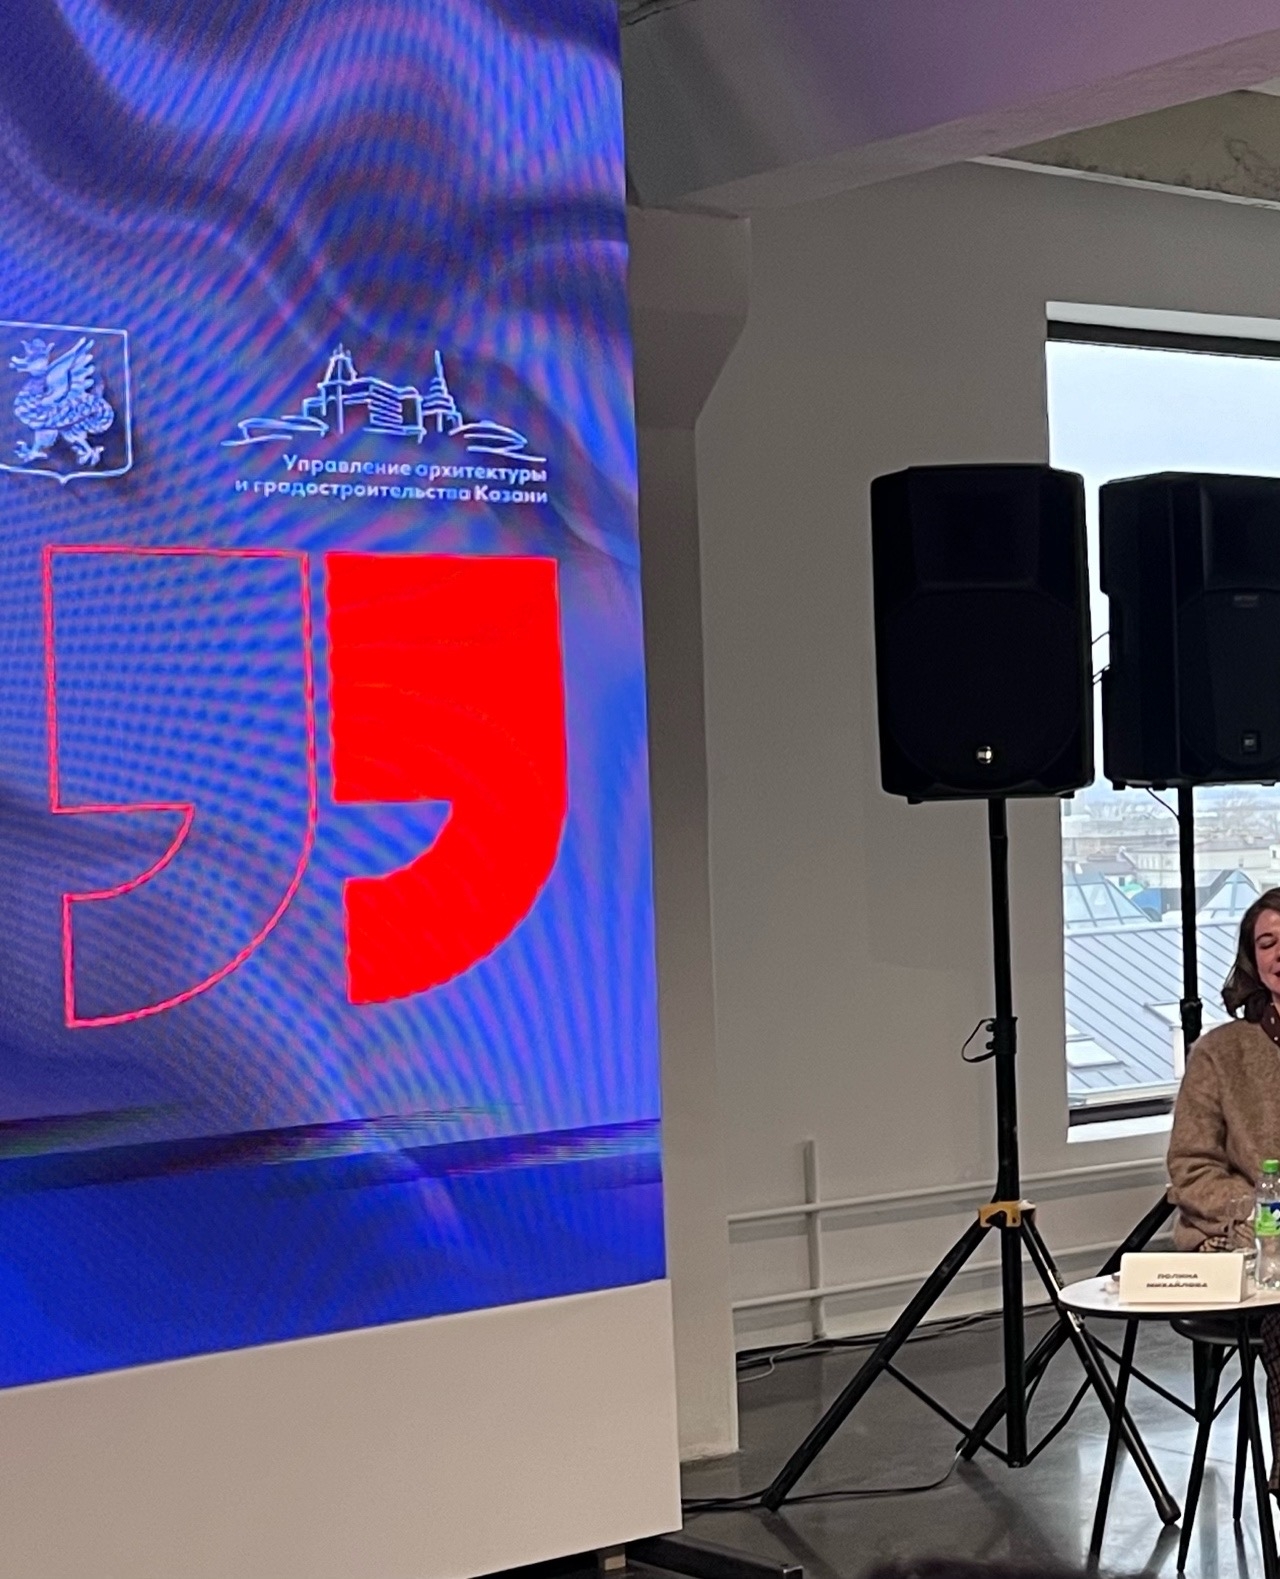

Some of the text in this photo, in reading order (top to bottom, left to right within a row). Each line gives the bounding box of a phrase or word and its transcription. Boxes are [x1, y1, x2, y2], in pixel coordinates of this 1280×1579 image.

[282, 453, 547, 485] Управление архитектуры
[235, 479, 548, 503] и градостроительства Казани
